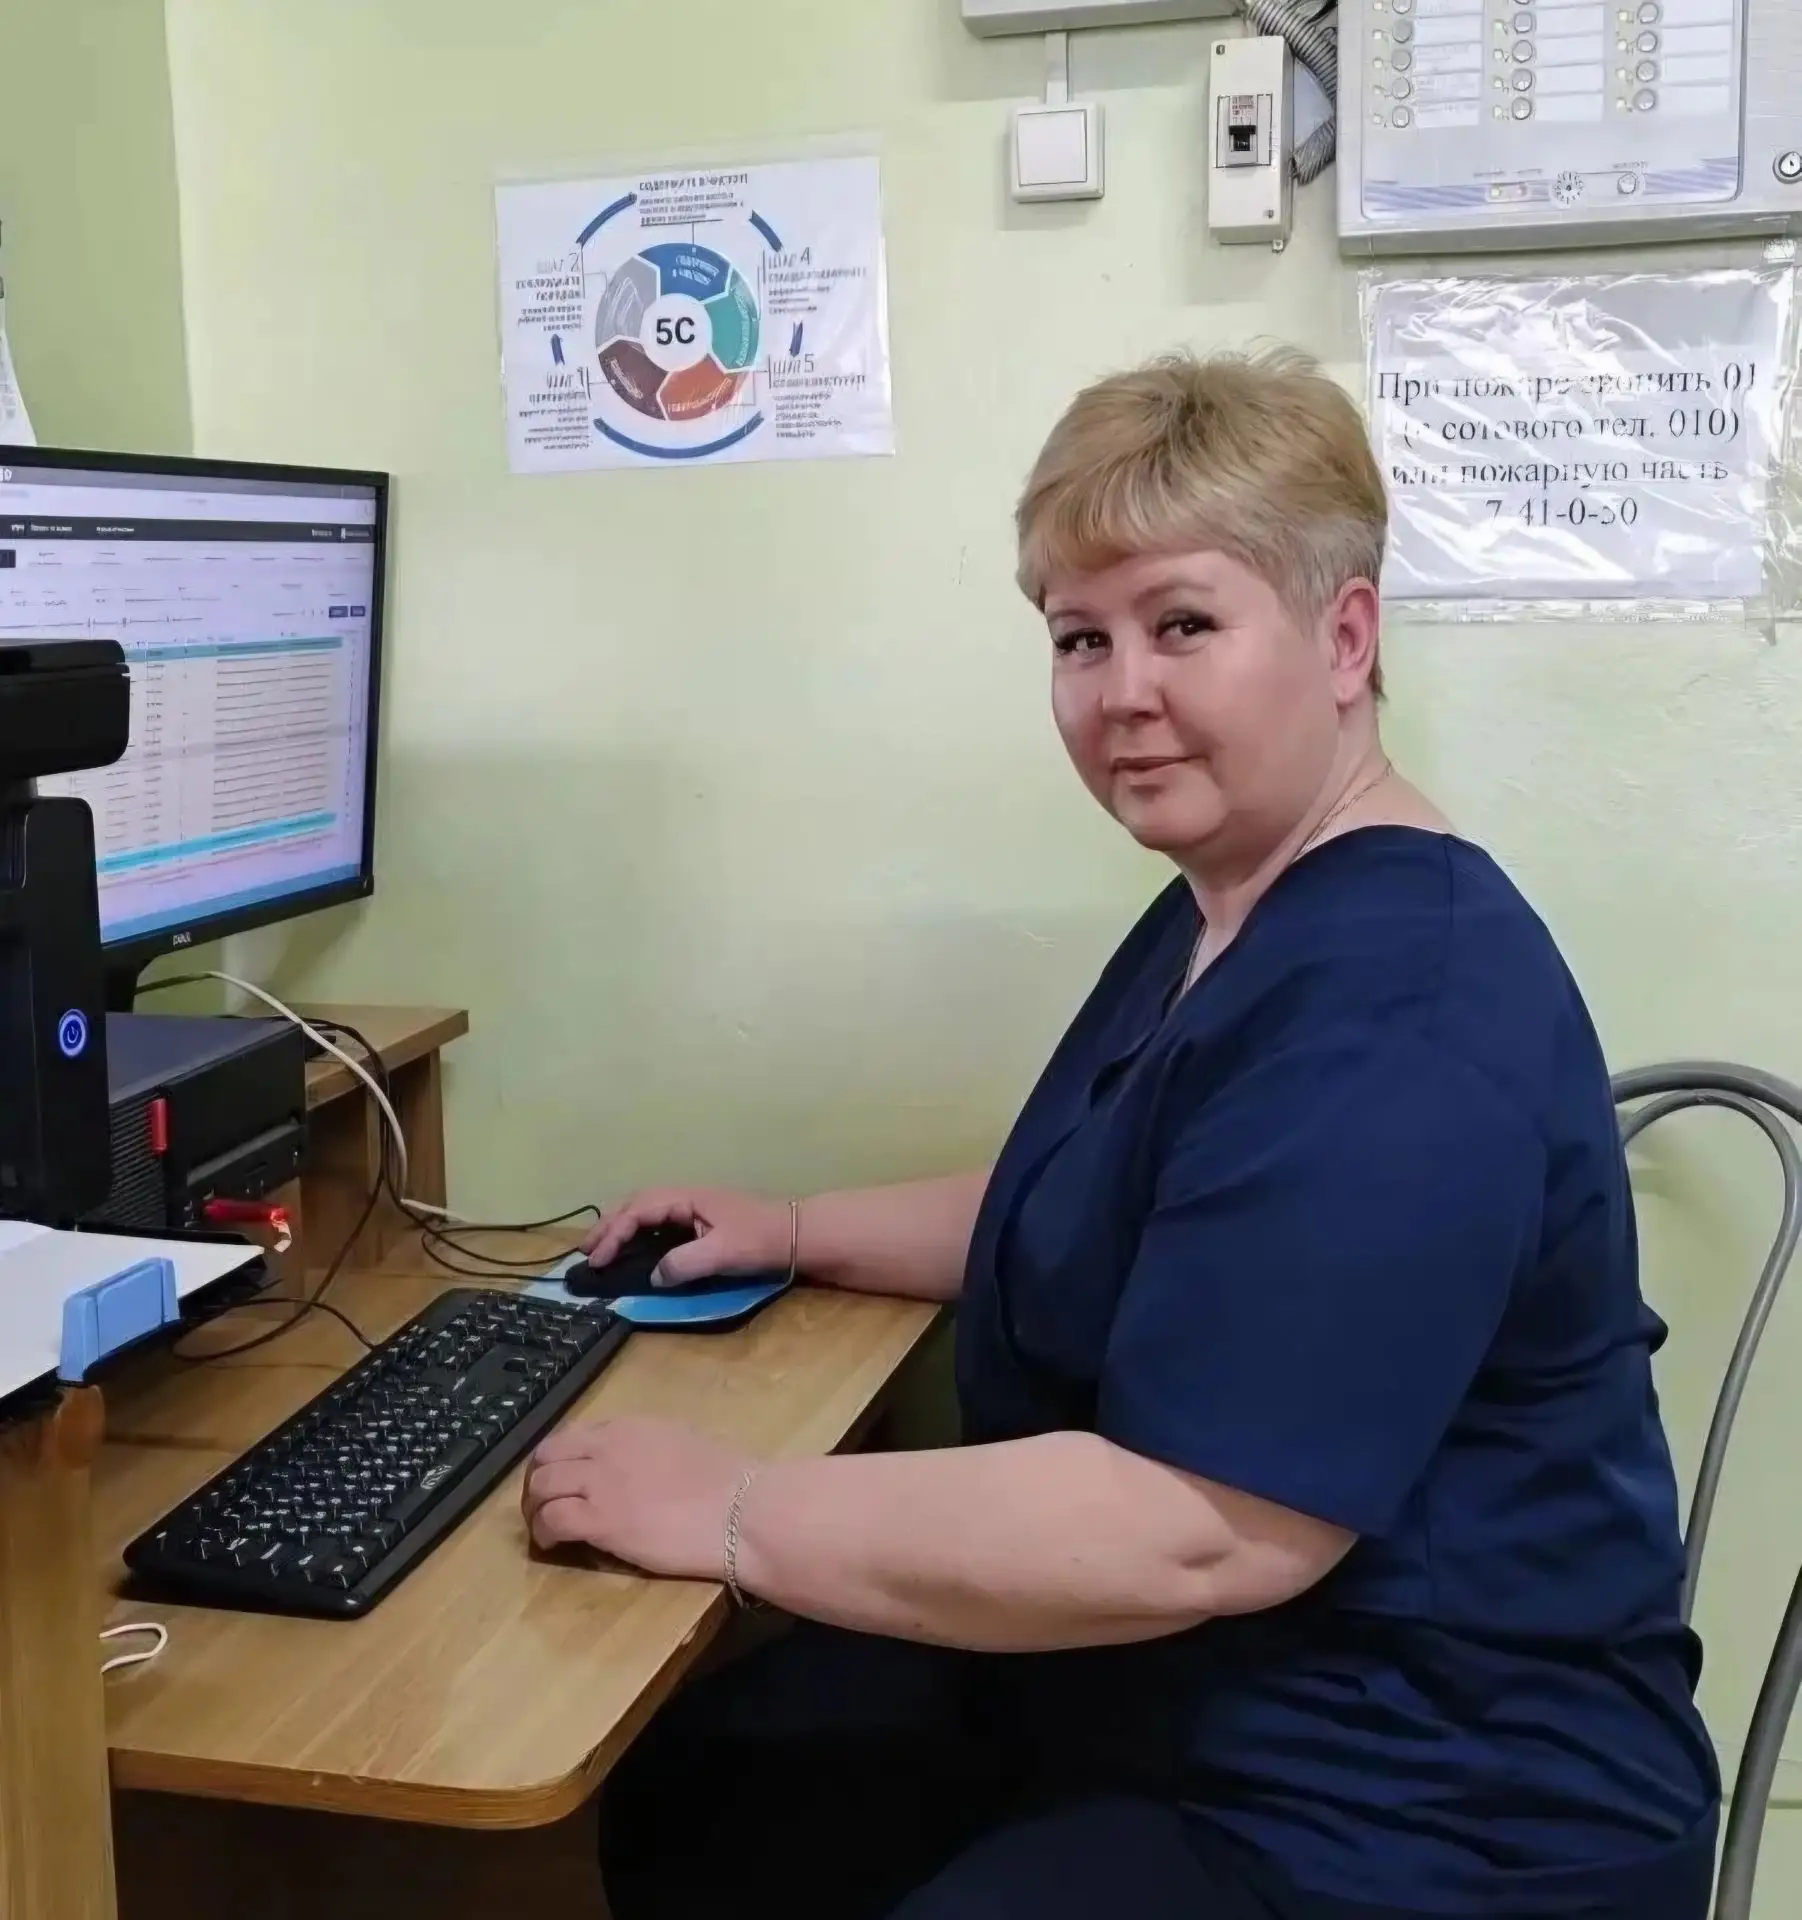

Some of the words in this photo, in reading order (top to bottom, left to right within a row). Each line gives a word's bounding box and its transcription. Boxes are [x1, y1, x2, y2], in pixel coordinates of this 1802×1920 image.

[804, 353, 814, 373] 5
[1377, 372, 1440, 406] При
[1453, 376, 1570, 404] пожре
[1582, 372, 1711, 394] вонить
[1724, 362, 1756, 392] 01
[1441, 420, 1583, 441] сотового
[1594, 417, 1655, 438] тел.
[1669, 408, 1740, 444] 010)
[1460, 461, 1628, 491] пожарную
